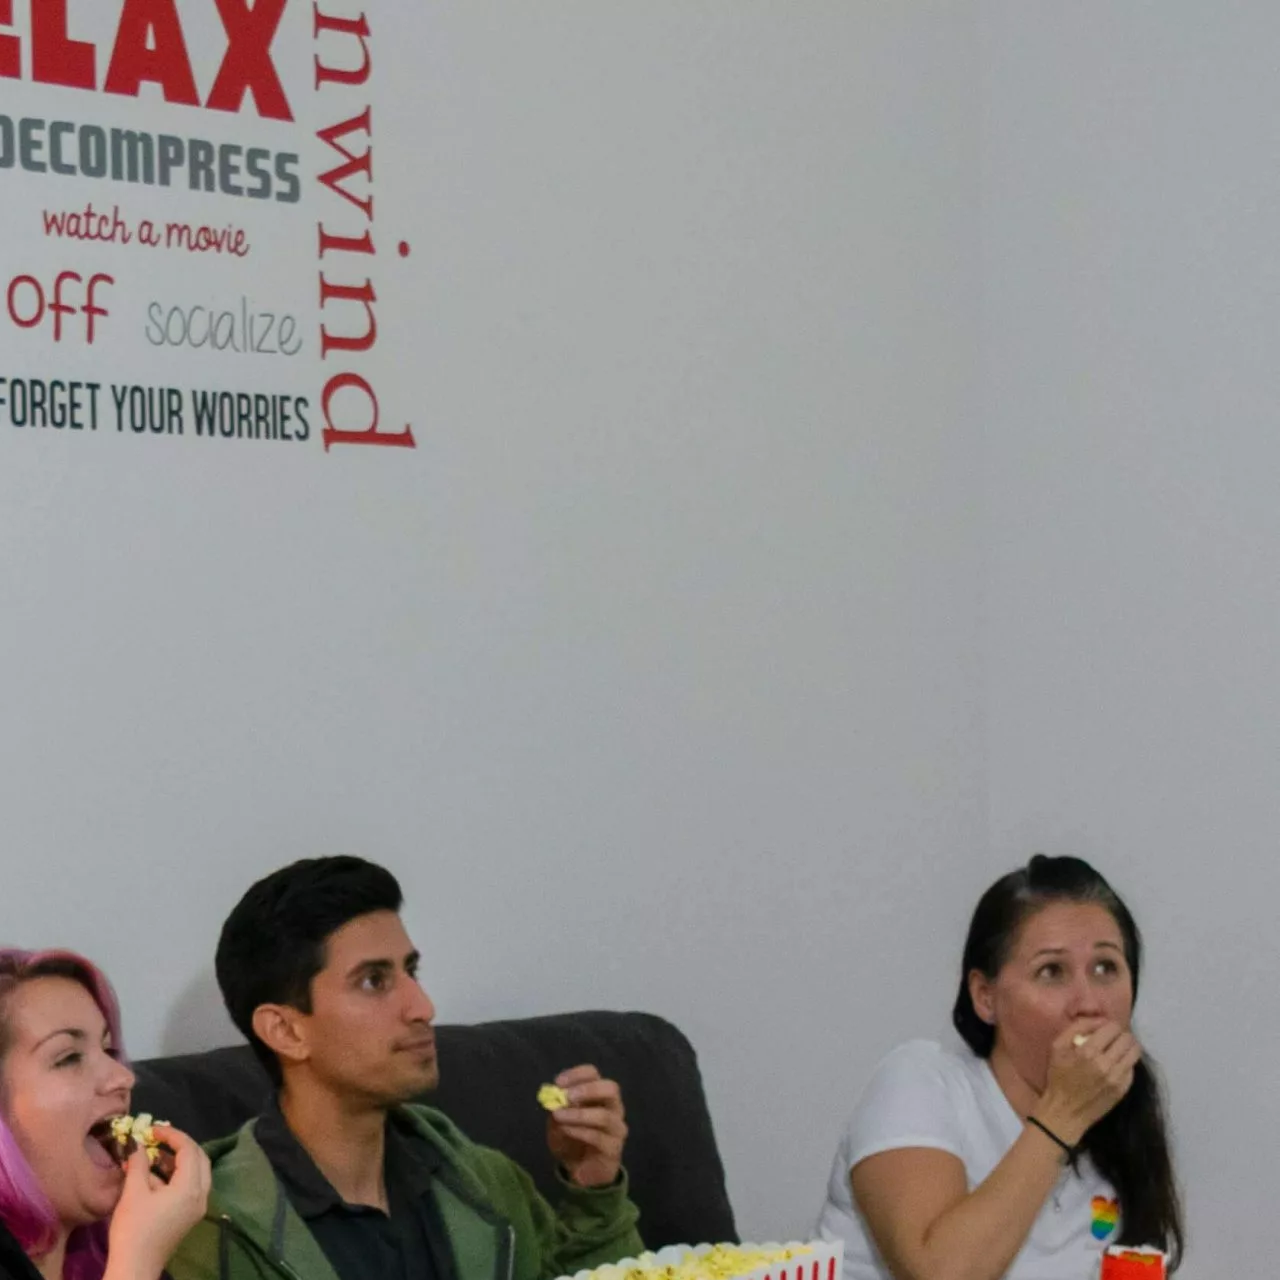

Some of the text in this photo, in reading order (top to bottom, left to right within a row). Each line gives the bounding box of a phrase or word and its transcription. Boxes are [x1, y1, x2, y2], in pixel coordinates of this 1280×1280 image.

[42, 203, 251, 257] watch a movie
[7, 270, 114, 344] off
[145, 296, 303, 356] socialize
[111, 384, 183, 436] YOUR
[192, 389, 310, 442] WORRIES
